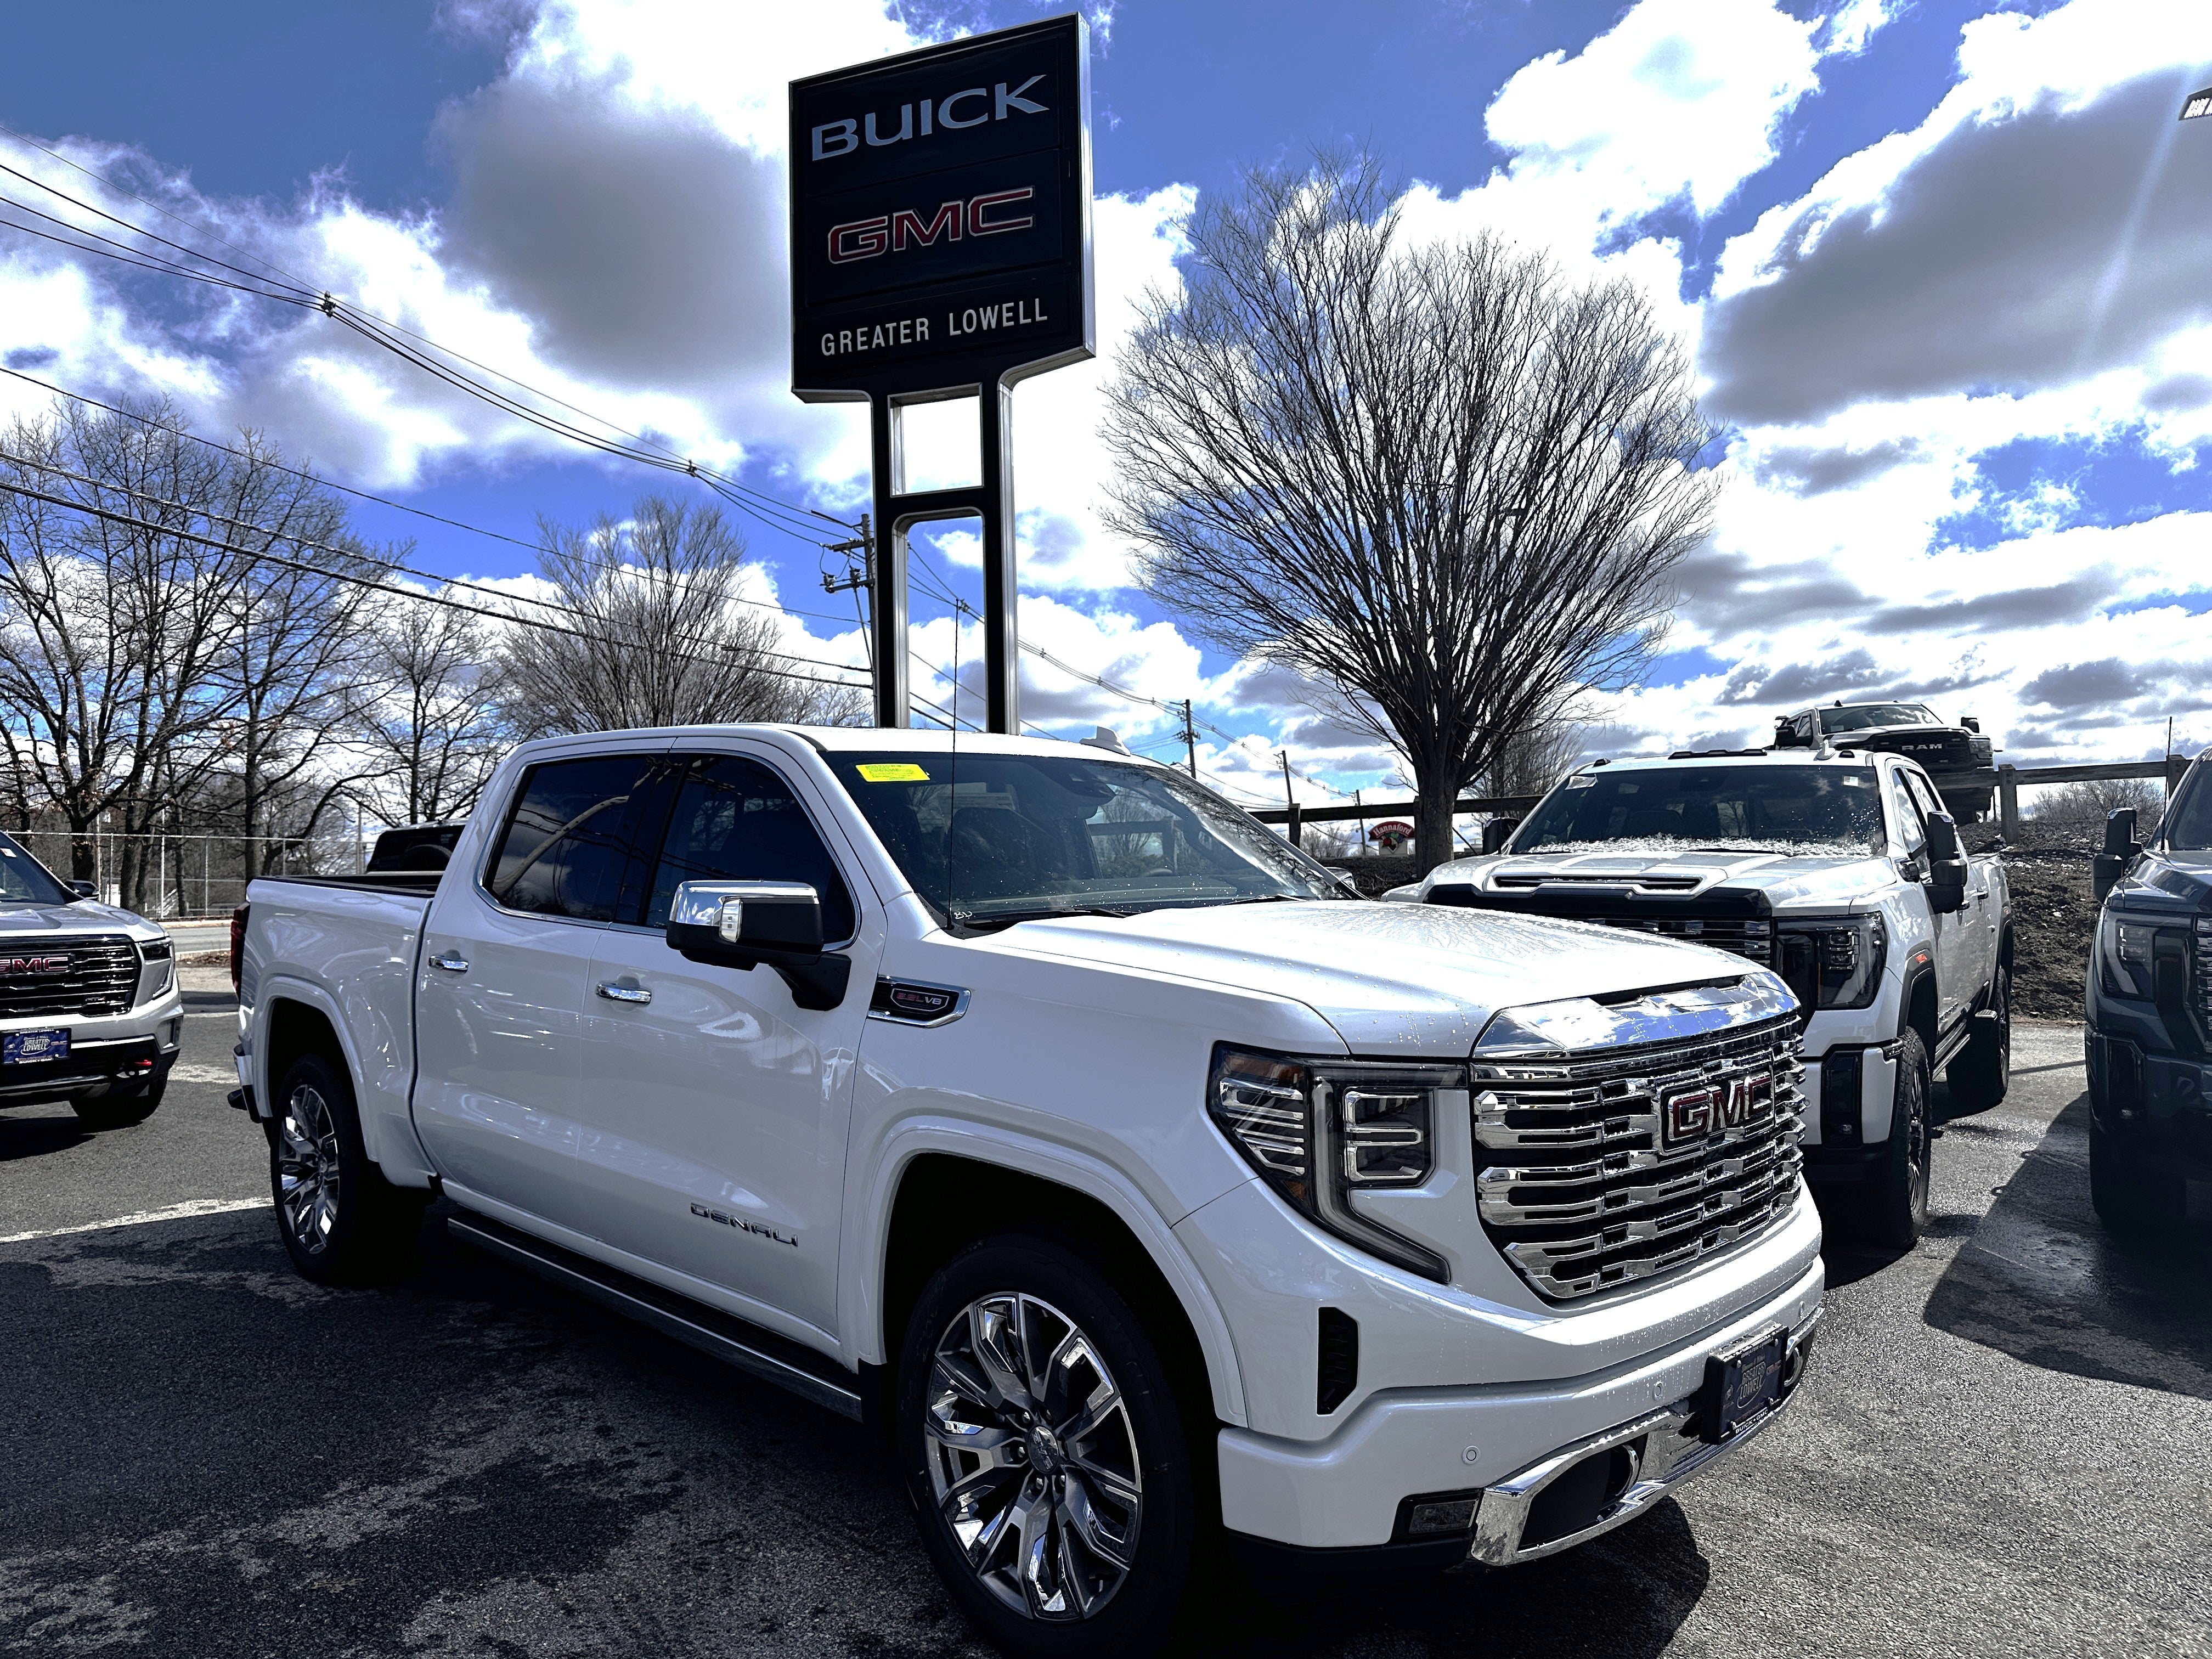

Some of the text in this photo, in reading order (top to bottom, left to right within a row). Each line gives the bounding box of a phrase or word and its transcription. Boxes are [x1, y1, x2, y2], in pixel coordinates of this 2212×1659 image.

[812, 75, 1049, 161] BUICK
[828, 185, 1035, 264] GMC
[821, 298, 1048, 356] GREATER LOWELL
[1373, 823, 1413, 836] Hannaford
[23, 1043, 47, 1052] LOWELL
[1668, 1071, 1771, 1141] GMC
[690, 1202, 798, 1247] DENALI
[1735, 1420, 1753, 1434] BUICK
